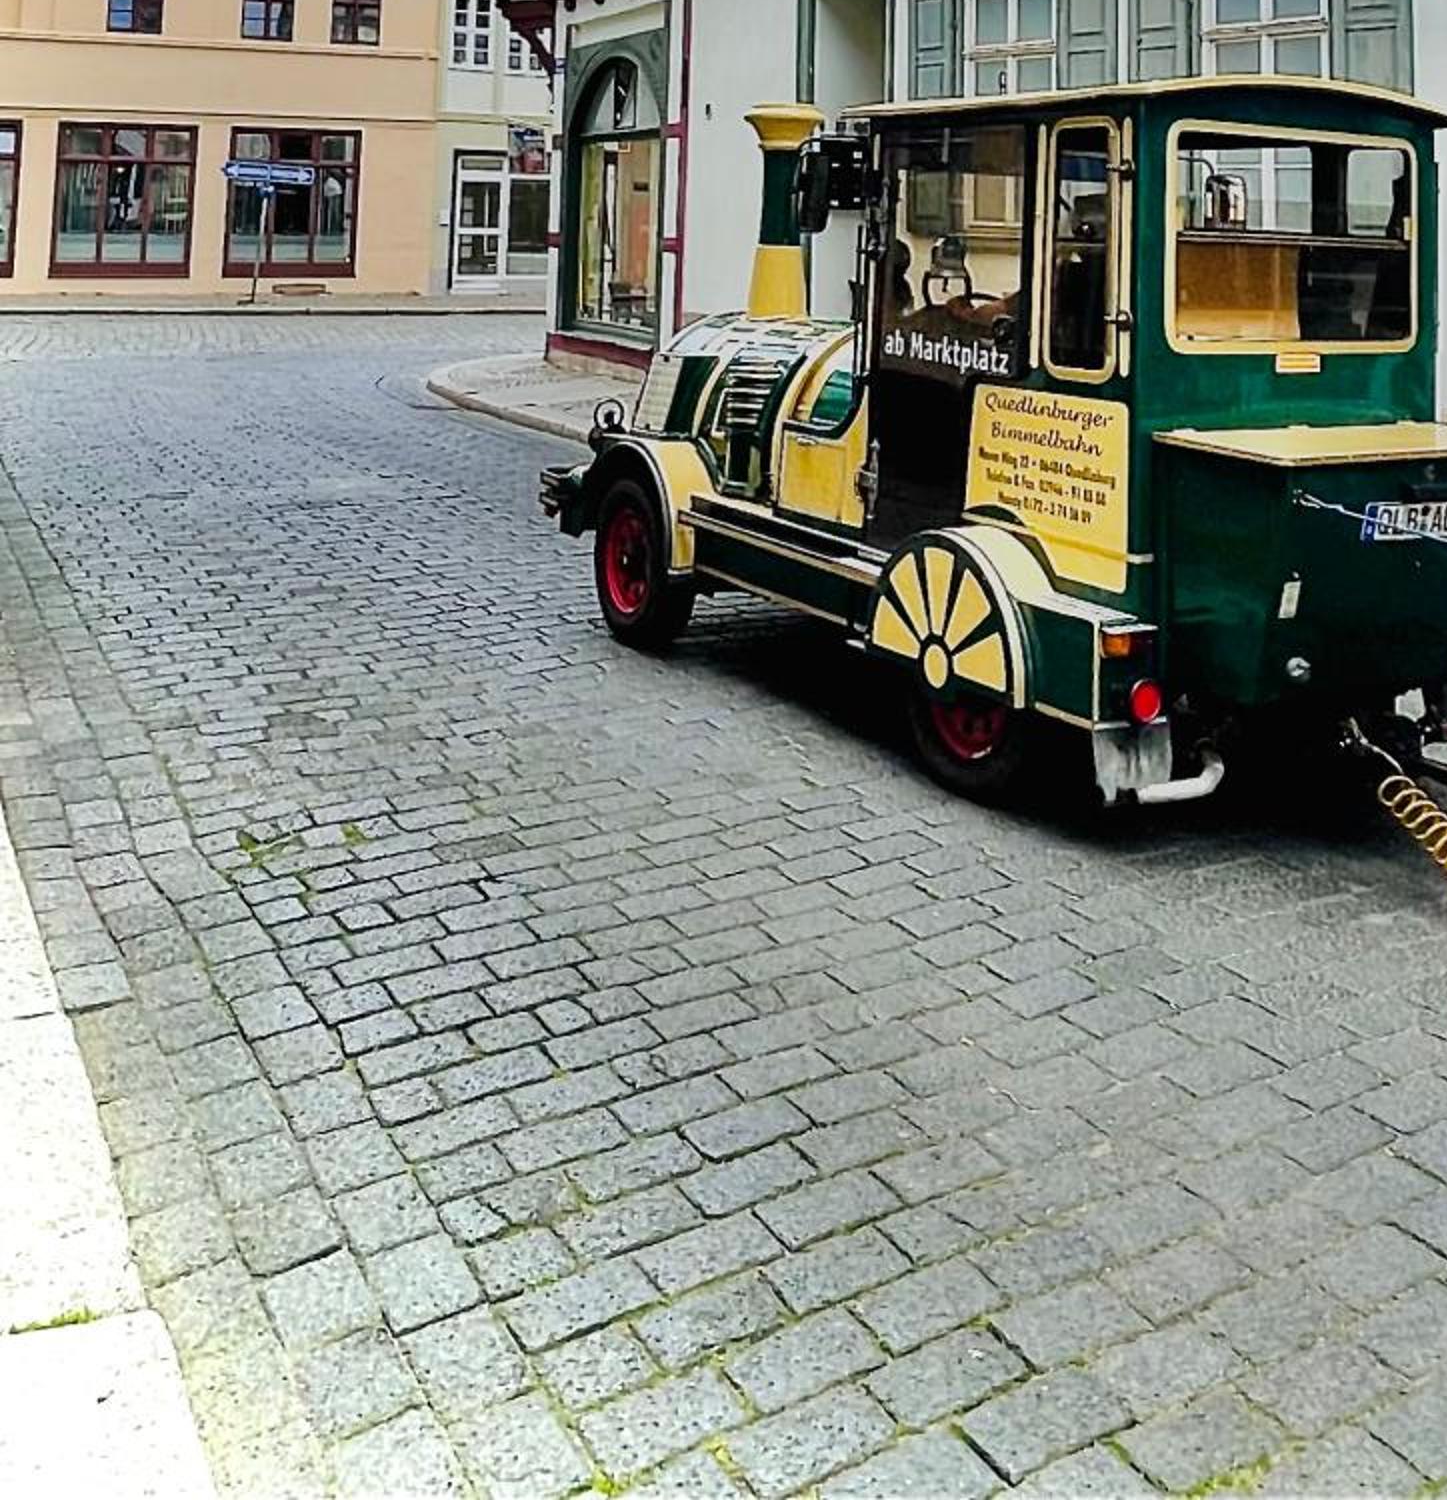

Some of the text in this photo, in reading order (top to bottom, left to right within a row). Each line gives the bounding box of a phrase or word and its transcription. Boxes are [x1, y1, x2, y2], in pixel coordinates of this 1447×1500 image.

[884, 329, 1009, 375] ab Marktplatz
[985, 391, 1114, 431] Quedlinburger
[991, 420, 1103, 457] Bimmelbahn
